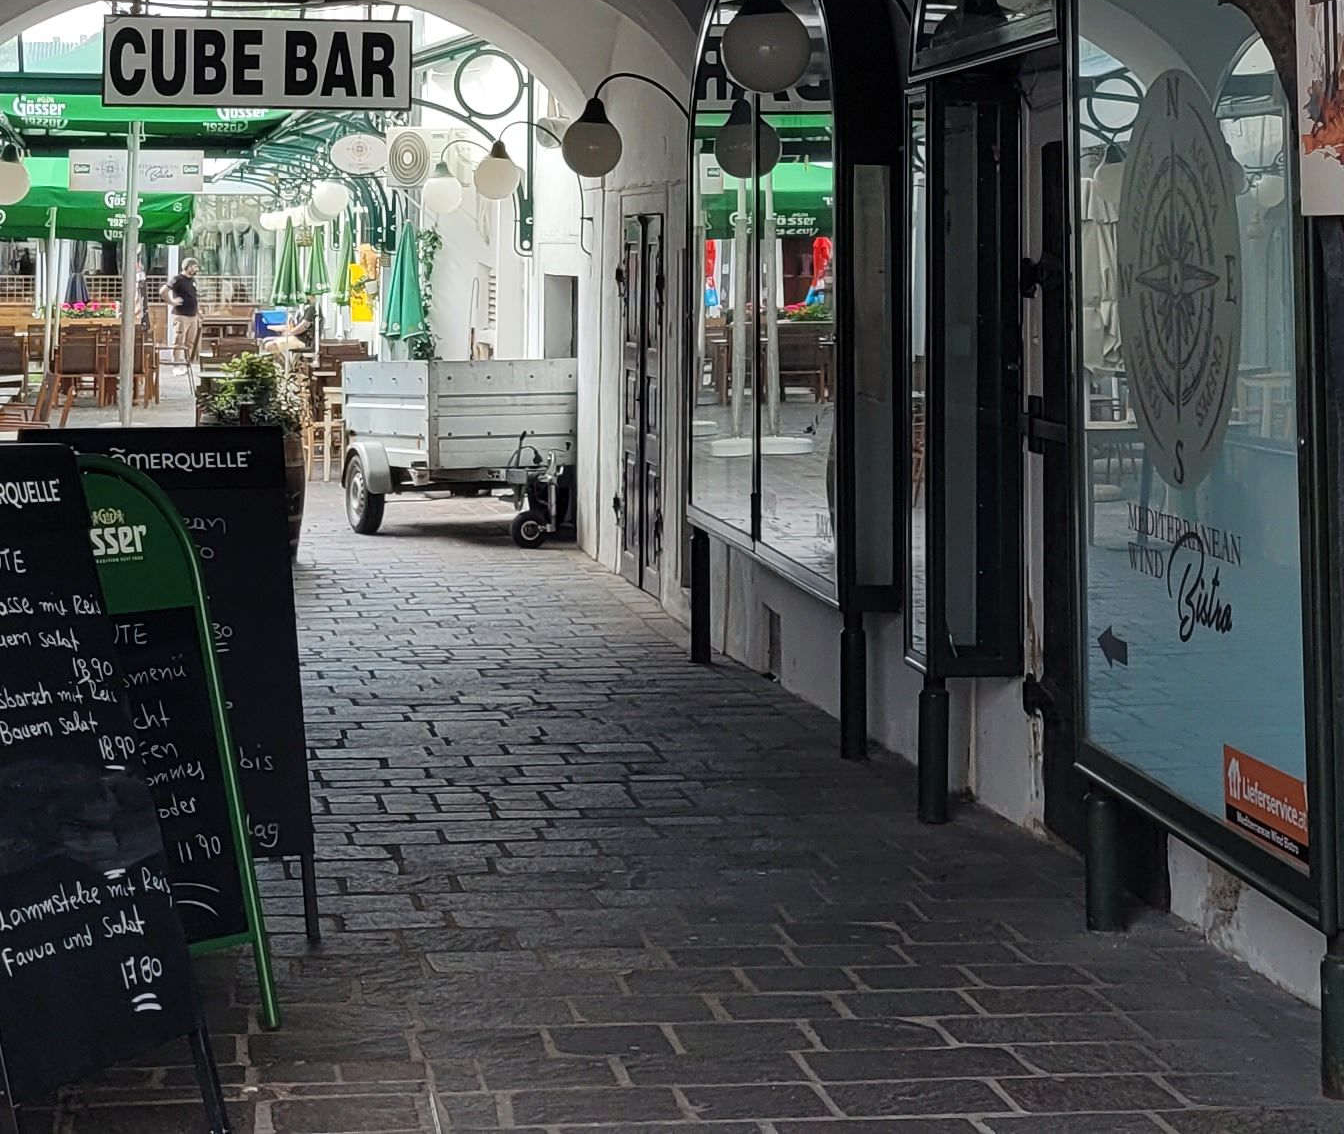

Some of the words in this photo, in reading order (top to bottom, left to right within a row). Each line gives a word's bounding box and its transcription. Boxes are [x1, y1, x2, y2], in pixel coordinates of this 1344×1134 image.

[109, 26, 264, 97] CUBE
[284, 29, 396, 98] BAR
[1127, 501, 1242, 567] MEDITERRANEAN
[1127, 541, 1164, 579] WIND
[1167, 531, 1233, 642] Bistro
[57, 681, 84, 704] mit
[157, 792, 198, 819] oder
[106, 877, 137, 899] mit
[63, 924, 93, 950] und
